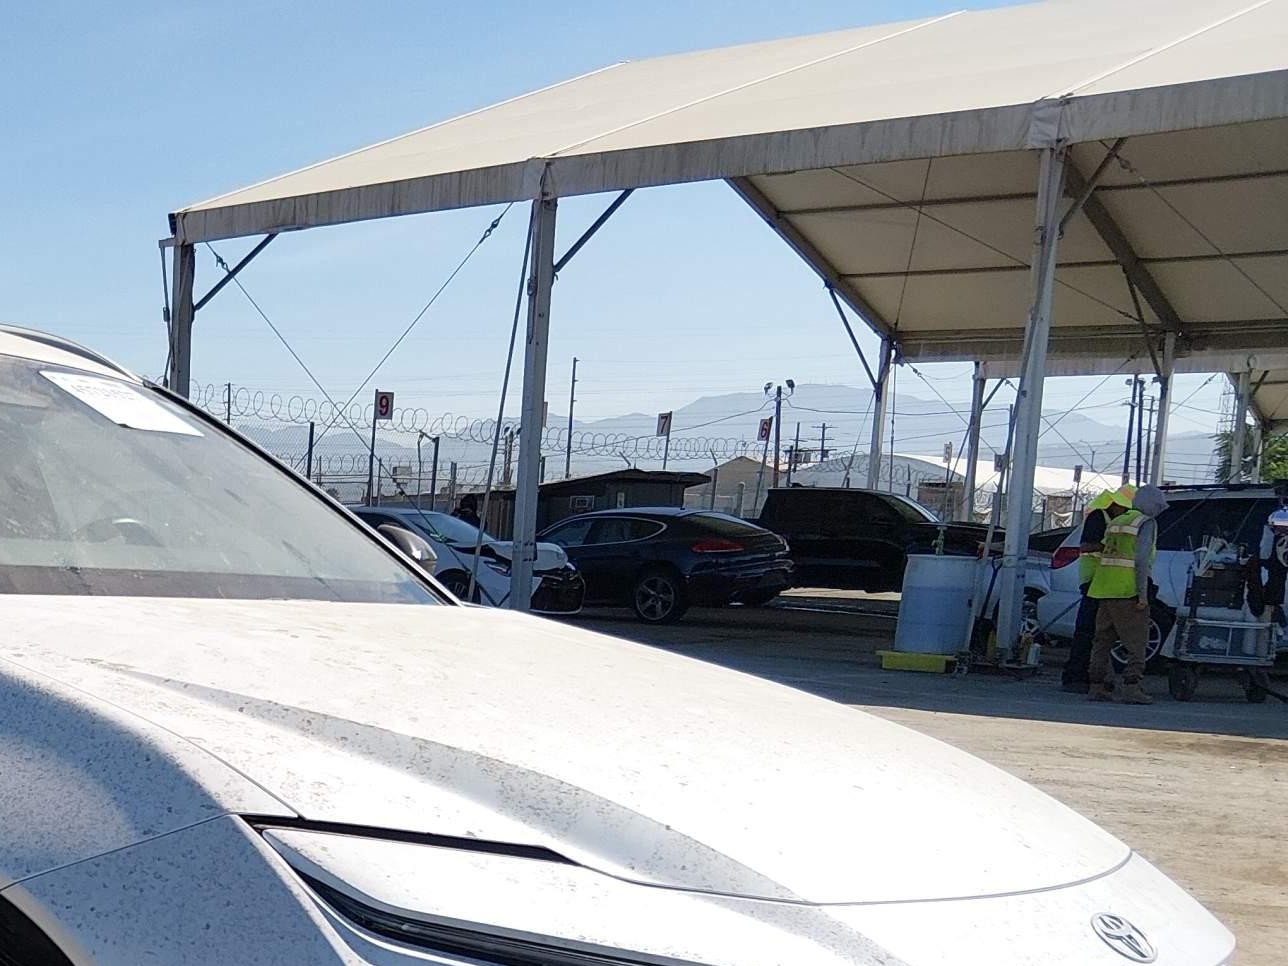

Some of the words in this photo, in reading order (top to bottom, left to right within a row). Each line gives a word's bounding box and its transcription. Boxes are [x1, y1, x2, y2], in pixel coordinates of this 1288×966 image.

[378, 395, 389, 416] 9
[660, 415, 669, 434] 7
[760, 421, 768, 438] 6
